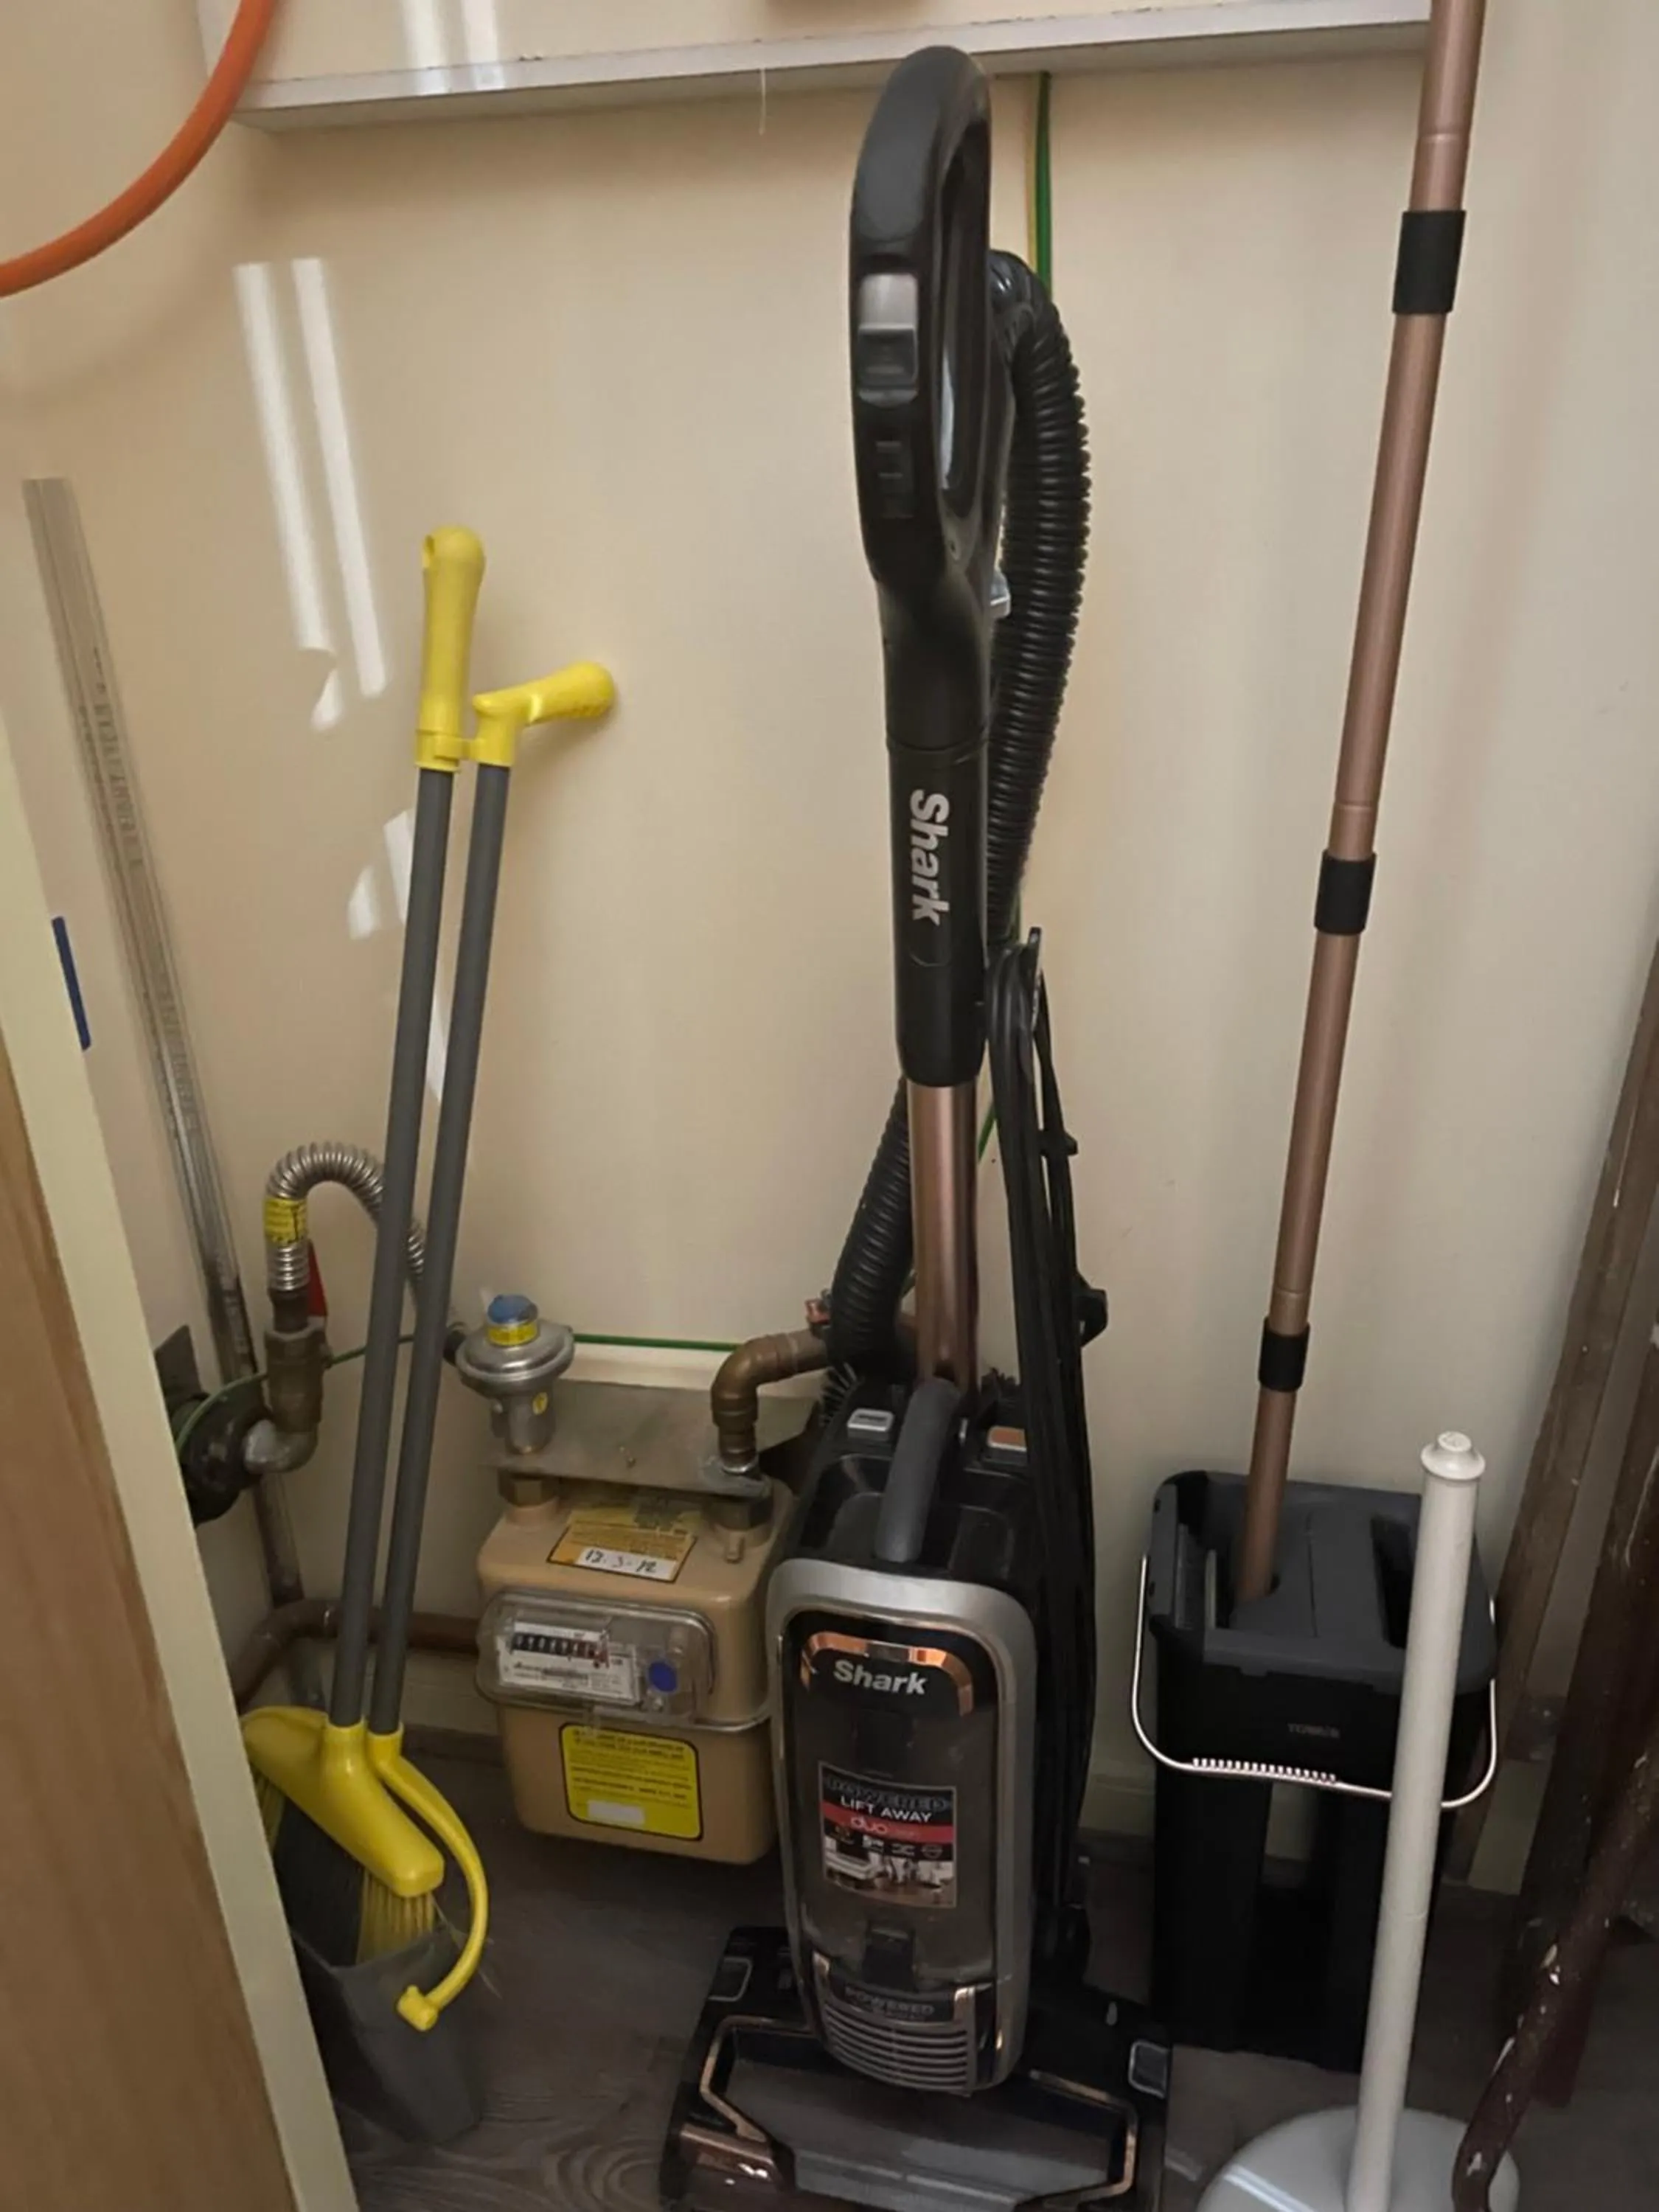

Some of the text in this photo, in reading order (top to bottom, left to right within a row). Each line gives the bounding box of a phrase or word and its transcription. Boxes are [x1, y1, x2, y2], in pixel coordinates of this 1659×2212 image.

[909, 789, 950, 926] Shark
[834, 1660, 926, 1694] Shark
[840, 1795, 933, 1823] LIFT AWAY
